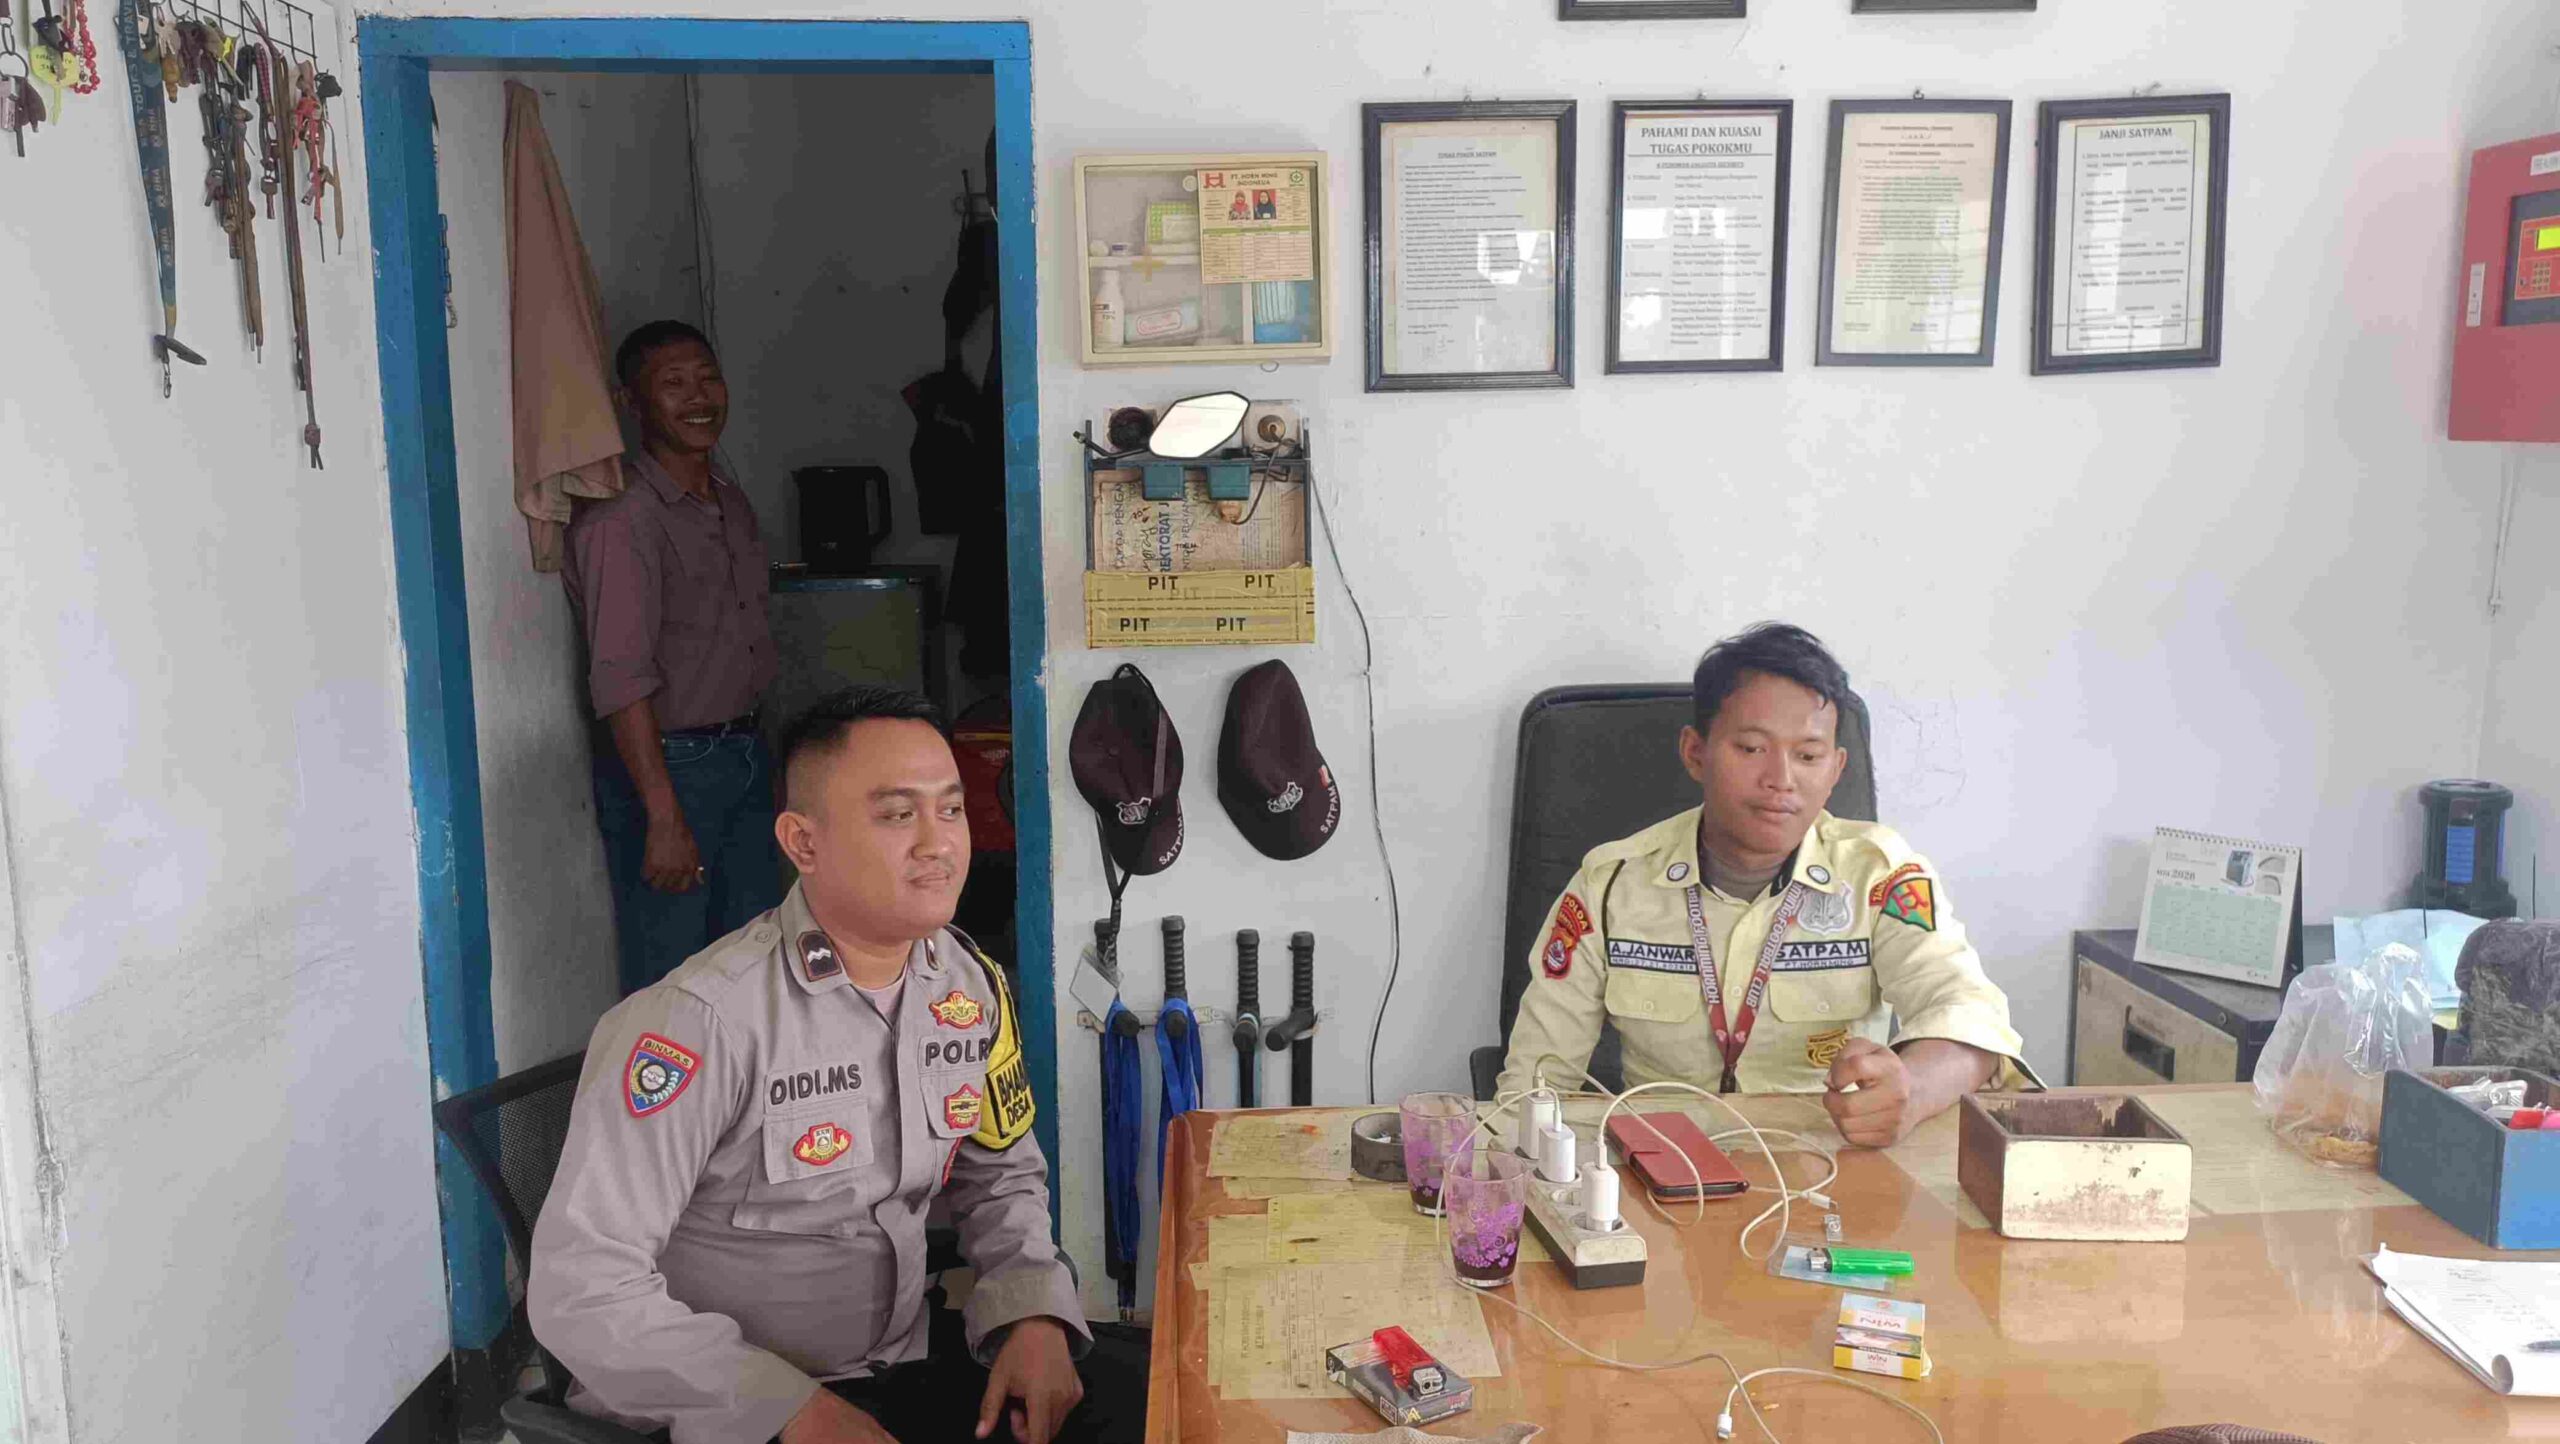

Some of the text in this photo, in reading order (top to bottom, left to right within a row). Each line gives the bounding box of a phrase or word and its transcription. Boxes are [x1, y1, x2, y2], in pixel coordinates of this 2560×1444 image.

[1641, 126, 1762, 138] PAHAMI DAN KUASAI
[2098, 127, 2173, 140] JANJI SATPAM
[1649, 143, 1752, 154] TUGAS POKOKMU
[1148, 574, 1275, 590] PIT PIT
[1120, 617, 1247, 632] PIT PIT
[1320, 785, 1339, 834] SATPAM
[1611, 942, 1695, 961] A.JANWAR
[1776, 941, 1863, 958] SATPAM
[1745, 977, 1764, 1008] CLUB
[644, 1040, 690, 1067] BINMAS
[770, 1063, 862, 1105] DIDI.MS
[1006, 1097, 1032, 1127] DESA
